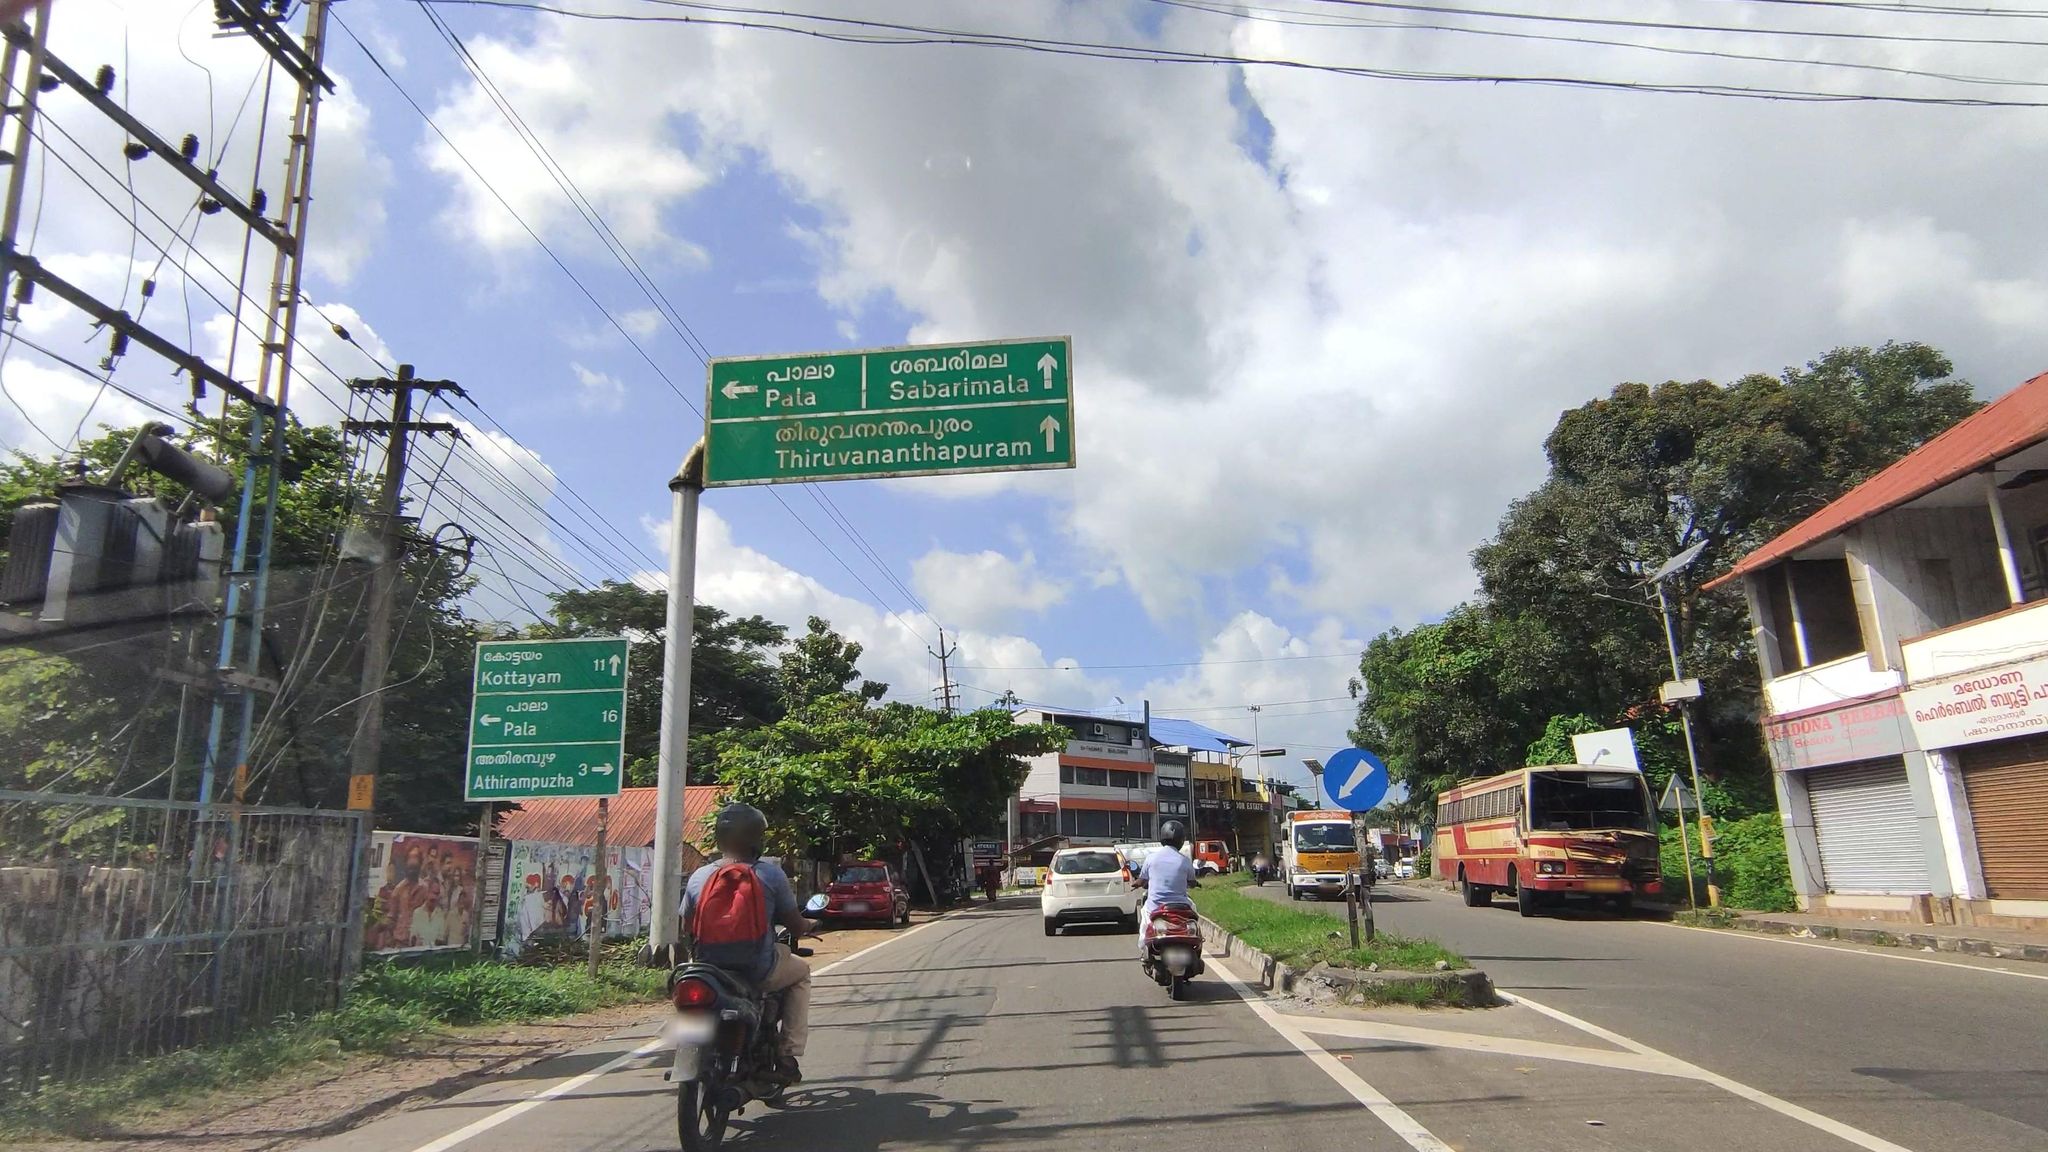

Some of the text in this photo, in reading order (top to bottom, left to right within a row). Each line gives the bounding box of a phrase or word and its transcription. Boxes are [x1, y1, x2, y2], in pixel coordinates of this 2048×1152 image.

[890, 350, 1008, 375] ശബരിമല
[766, 363, 835, 383] പാലാ
[889, 375, 1030, 401] Sabarimala
[765, 389, 817, 408] Pala
[775, 419, 973, 447] തിരുവനന്തപുരം
[775, 438, 1032, 470] Thiruvananthapuram
[483, 651, 543, 666] കോട്ടയം
[593, 659, 606, 672] 11
[481, 671, 562, 688] Kottayam
[1953, 671, 2024, 696] മഡോണ
[506, 701, 549, 713] പാലാ
[601, 710, 618, 723] 16
[503, 721, 537, 737] Pala
[475, 751, 557, 768] അതിരമ്പുഴ
[578, 763, 588, 777] 3
[473, 774, 574, 791] Athirampuzha
